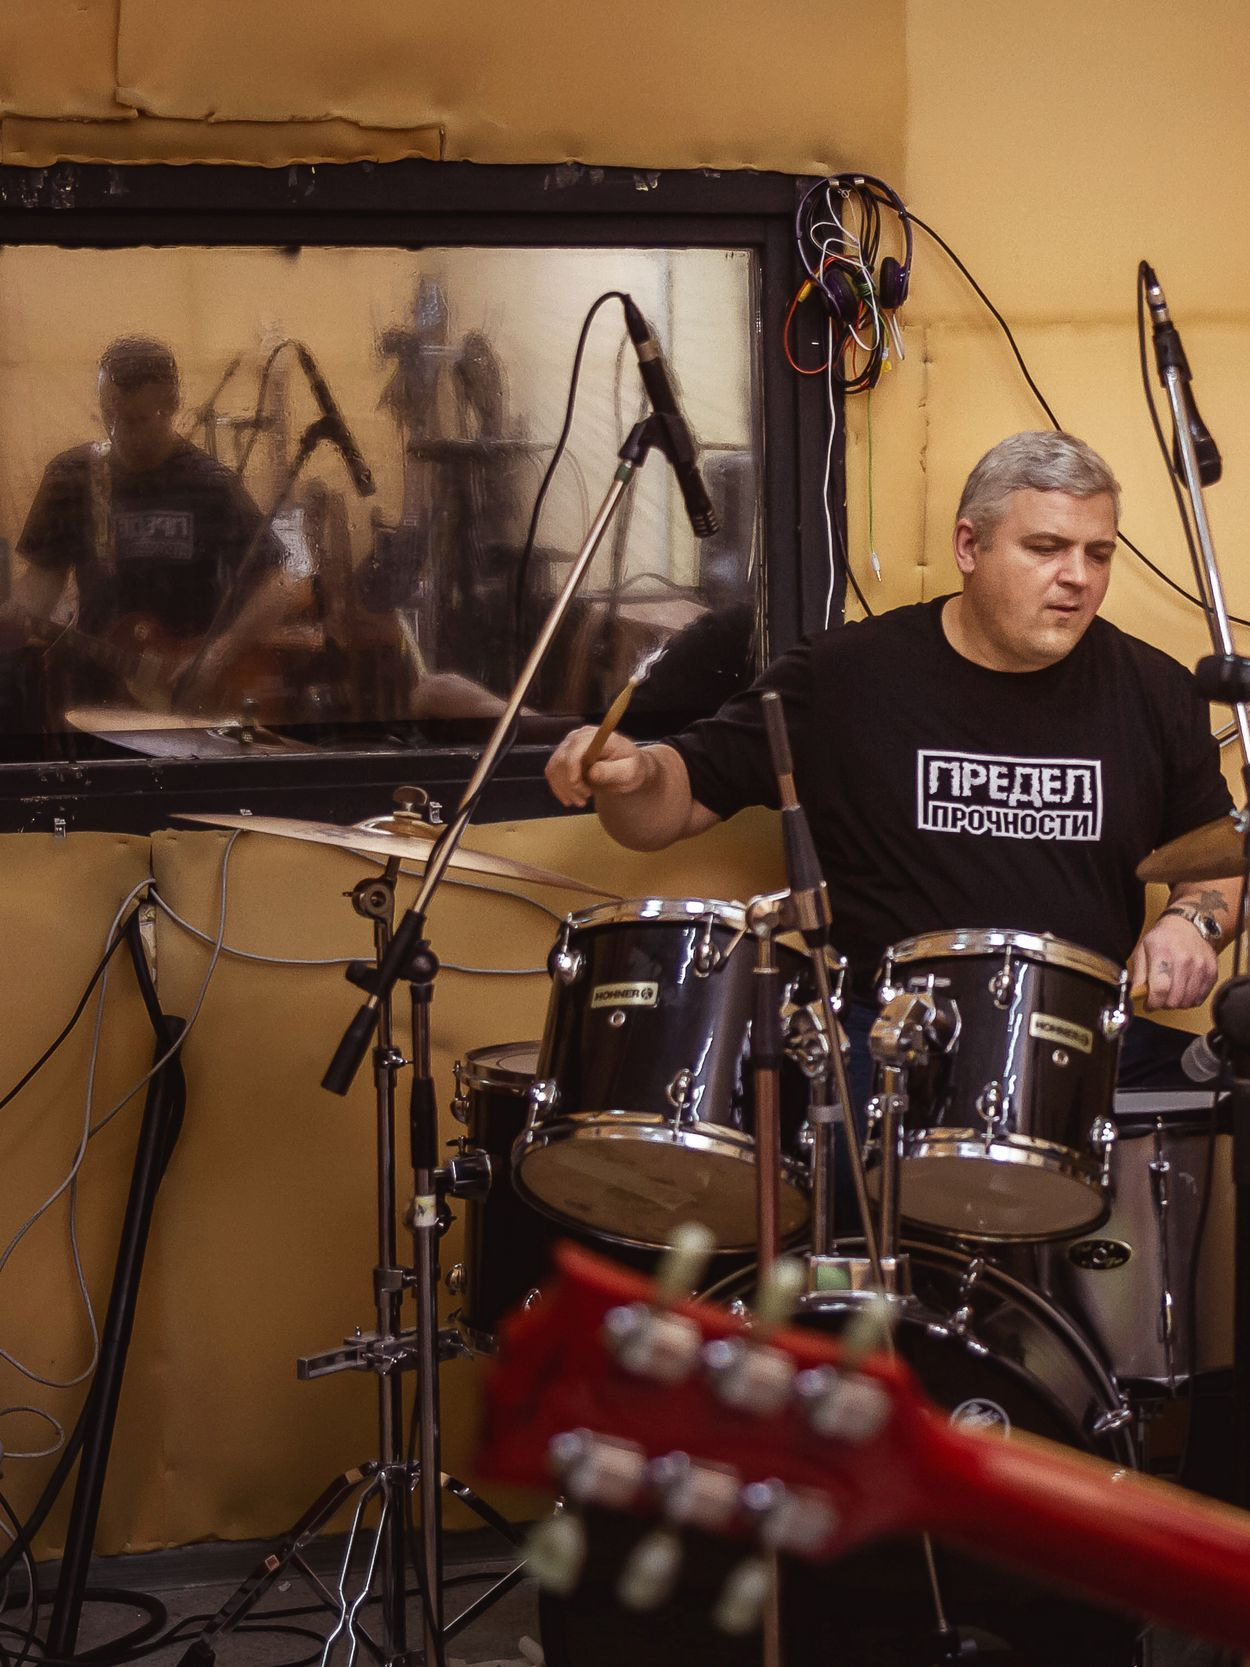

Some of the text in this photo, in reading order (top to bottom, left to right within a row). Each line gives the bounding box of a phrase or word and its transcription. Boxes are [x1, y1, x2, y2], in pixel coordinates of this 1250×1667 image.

[929, 761, 1092, 807] ПРЕДЕЛ
[930, 802, 1091, 839] ПРОЧНОСТИ
[595, 989, 640, 1000] HOHNER
